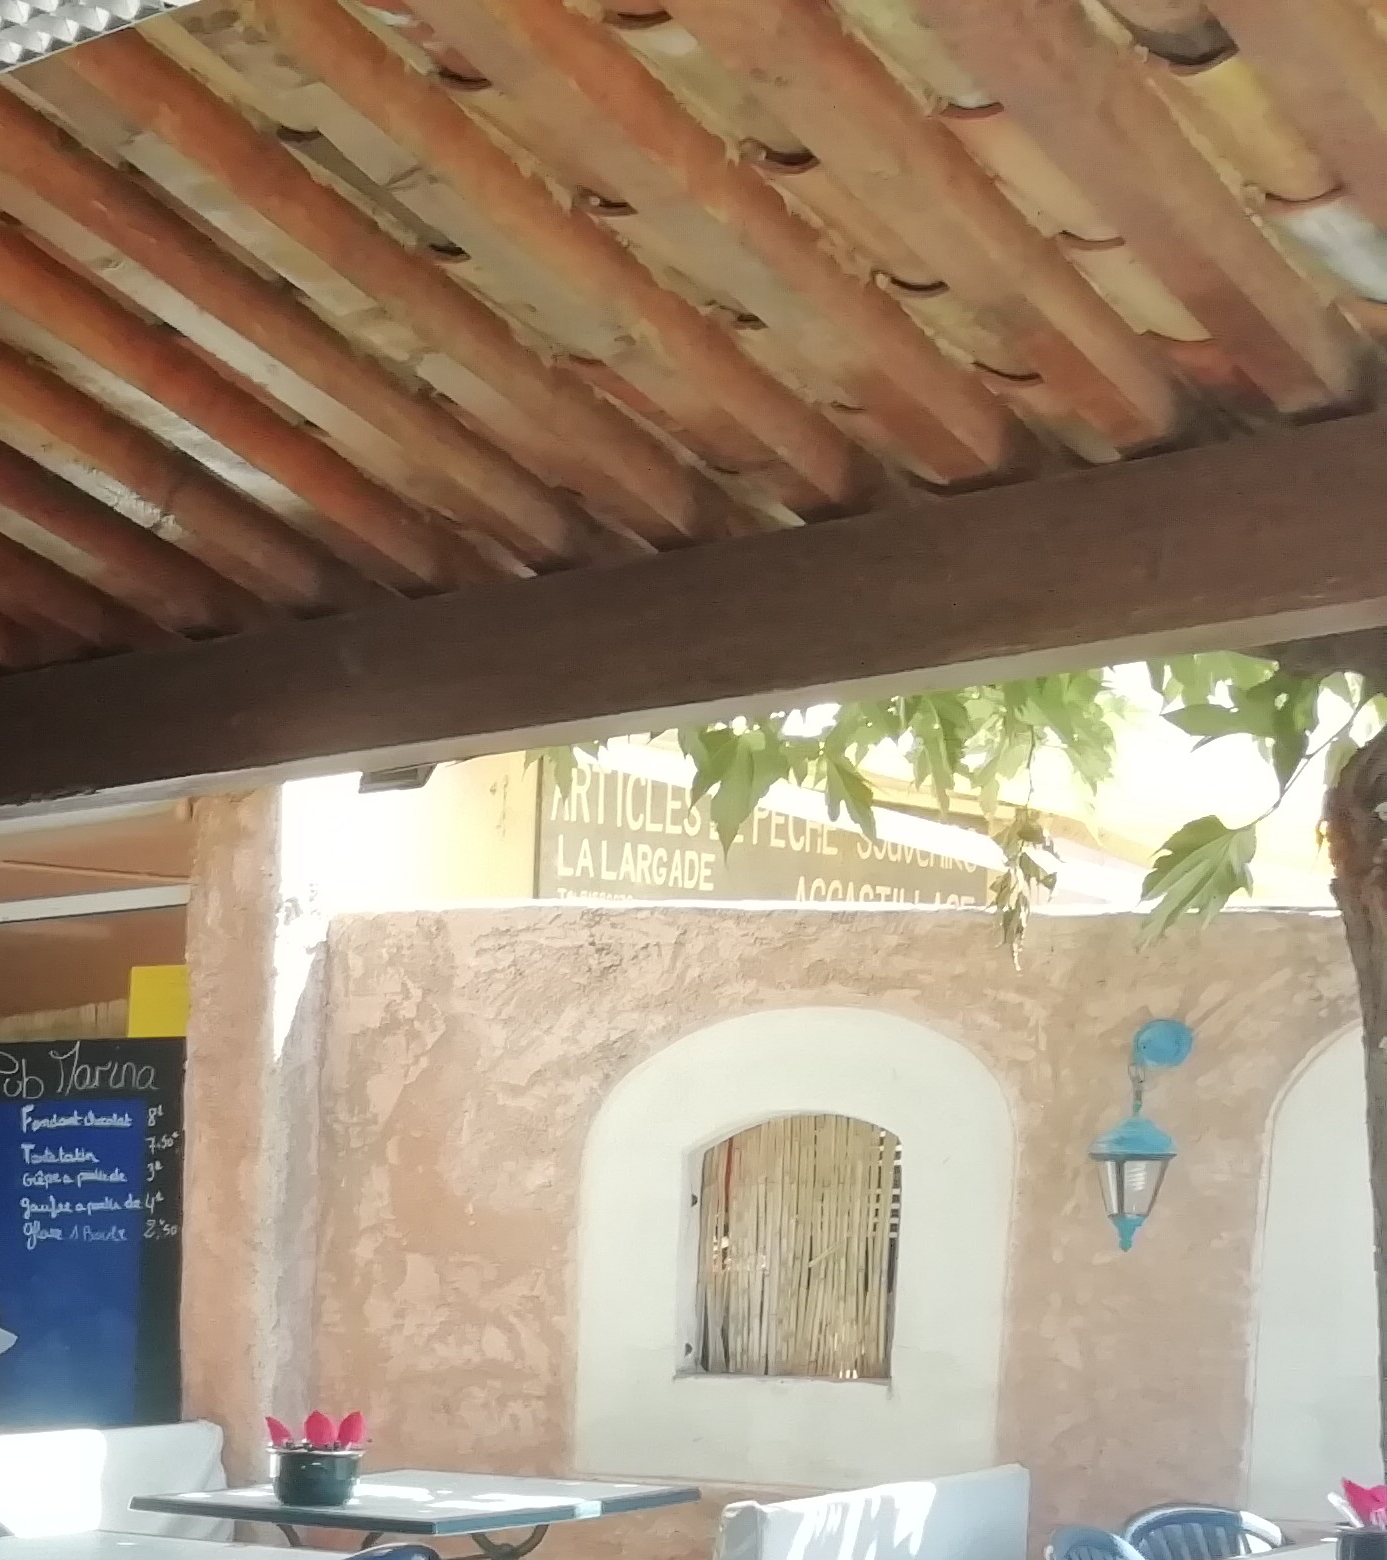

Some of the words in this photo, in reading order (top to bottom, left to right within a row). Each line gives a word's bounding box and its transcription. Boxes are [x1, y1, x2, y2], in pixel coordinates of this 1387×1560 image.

[557, 834, 594, 878] LA
[600, 839, 715, 891] LARGADE
[49, 1041, 160, 1097] Marina
